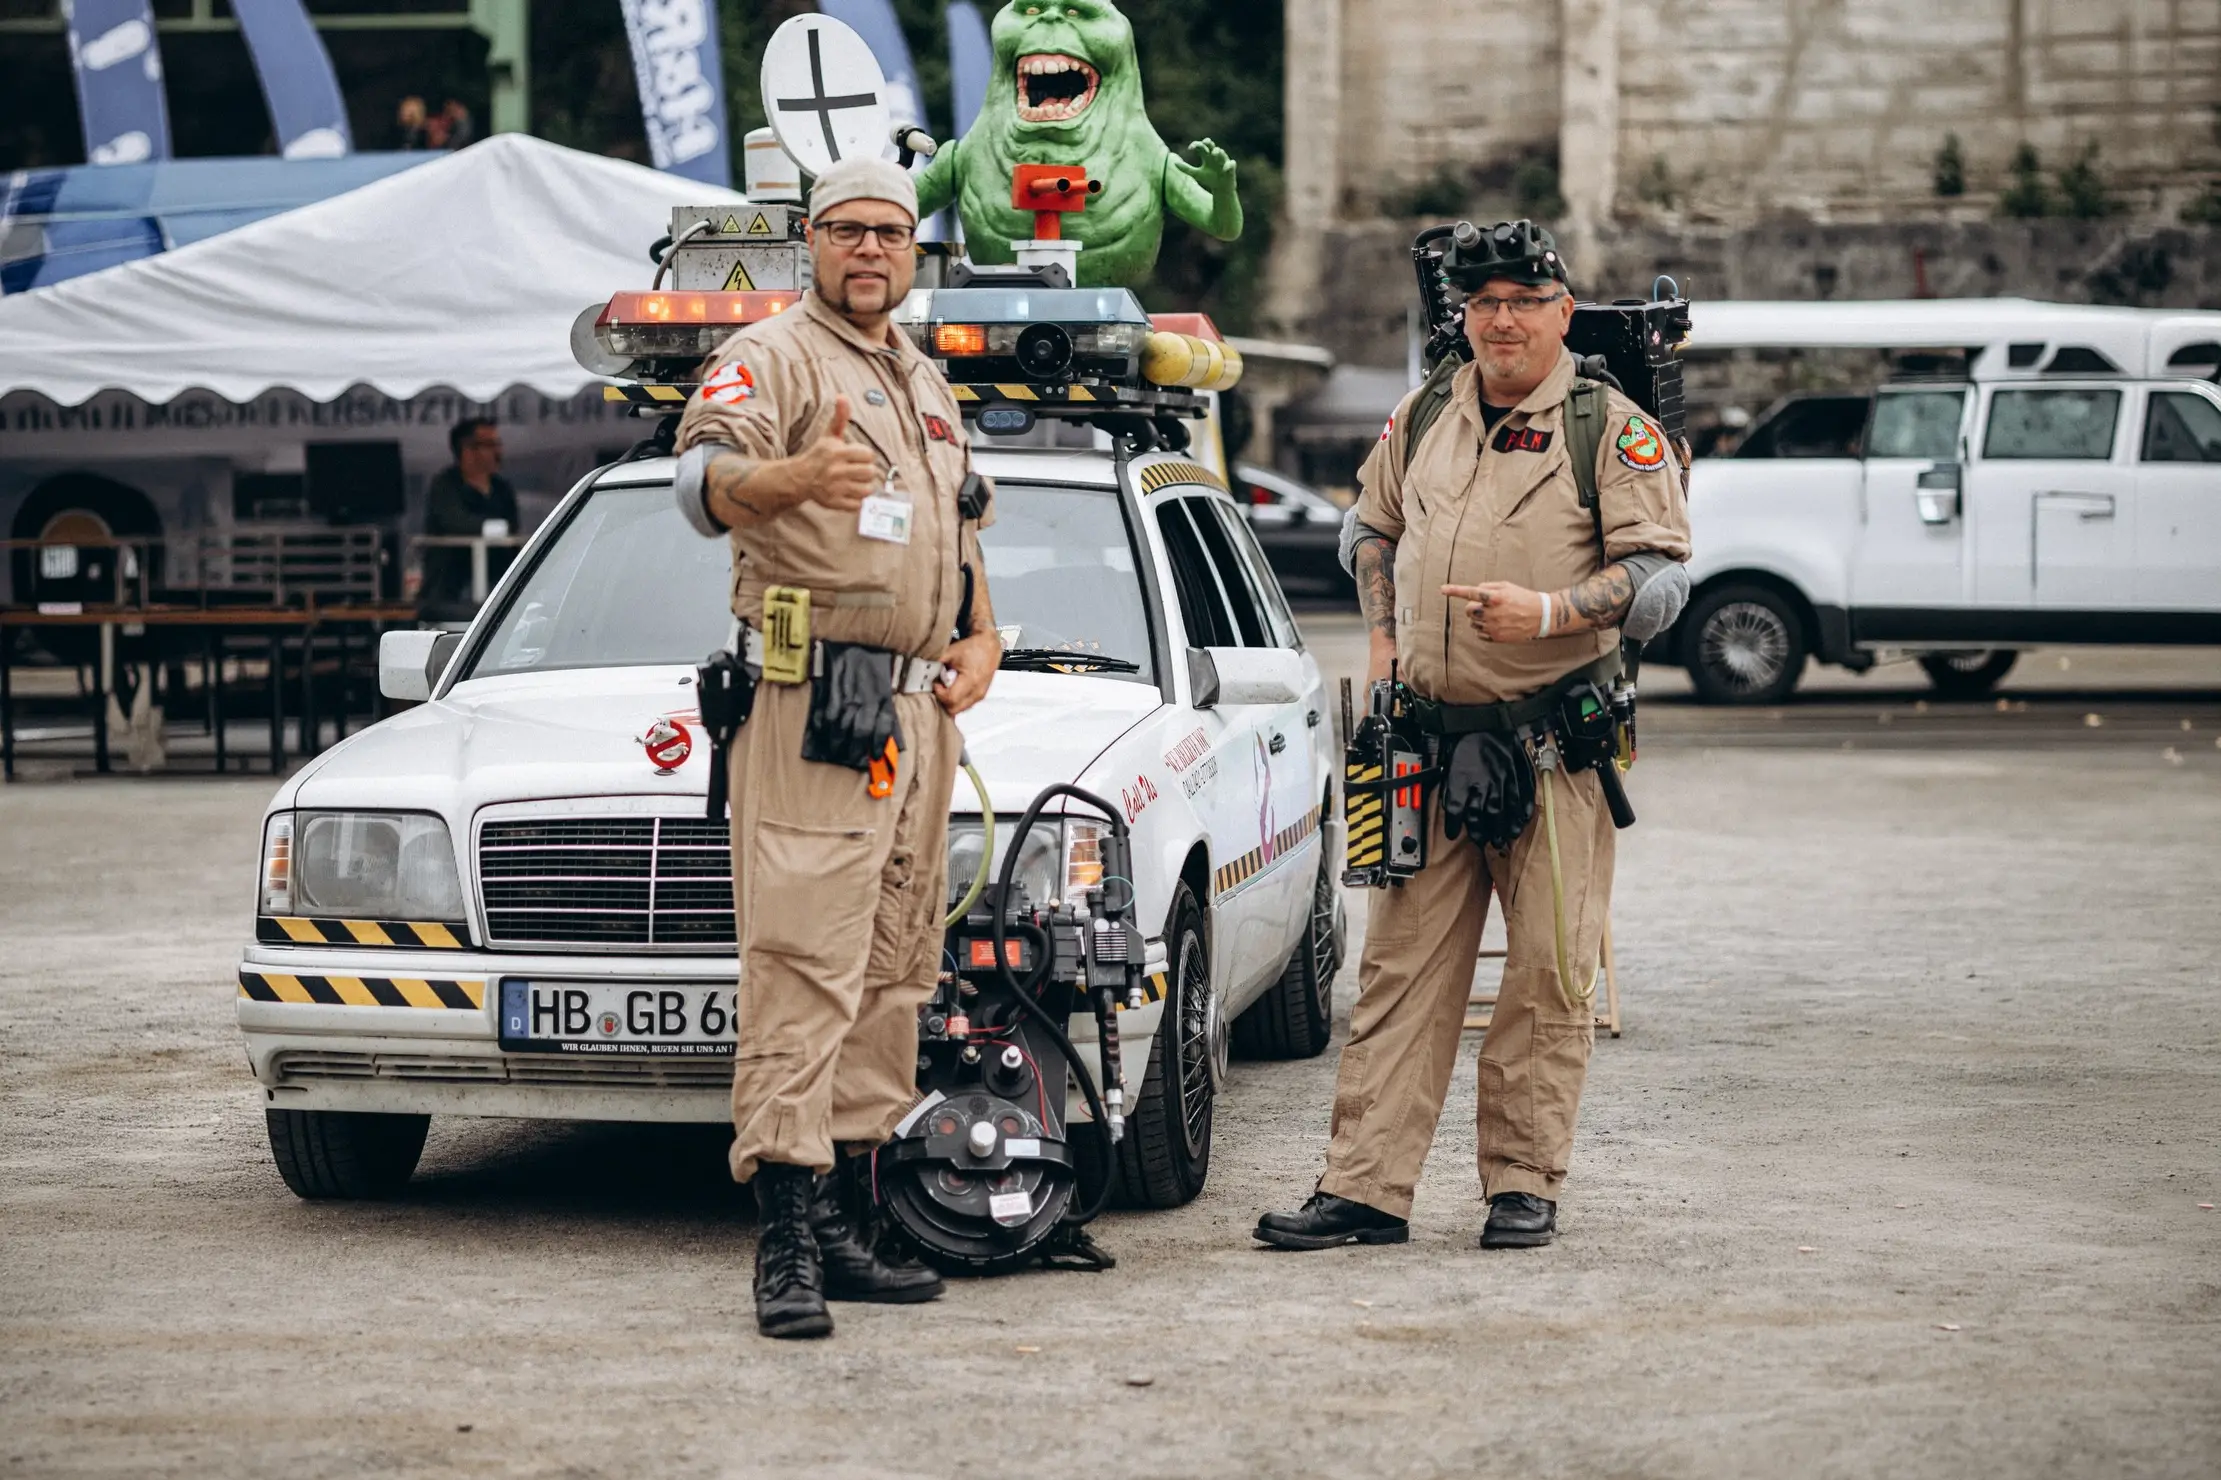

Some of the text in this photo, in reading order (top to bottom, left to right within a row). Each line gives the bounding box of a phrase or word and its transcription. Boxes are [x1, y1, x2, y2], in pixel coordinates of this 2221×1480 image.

[1122, 783, 1145, 824] Call
[511, 1017, 521, 1030] D
[532, 989, 739, 1036] HB GB 6
[561, 1043, 579, 1051] WIR
[579, 1043, 618, 1052] GLAUBEN
[619, 1045, 650, 1054] IHNEN,
[651, 1045, 679, 1053] RUFEN
[681, 1045, 694, 1053] SIE
